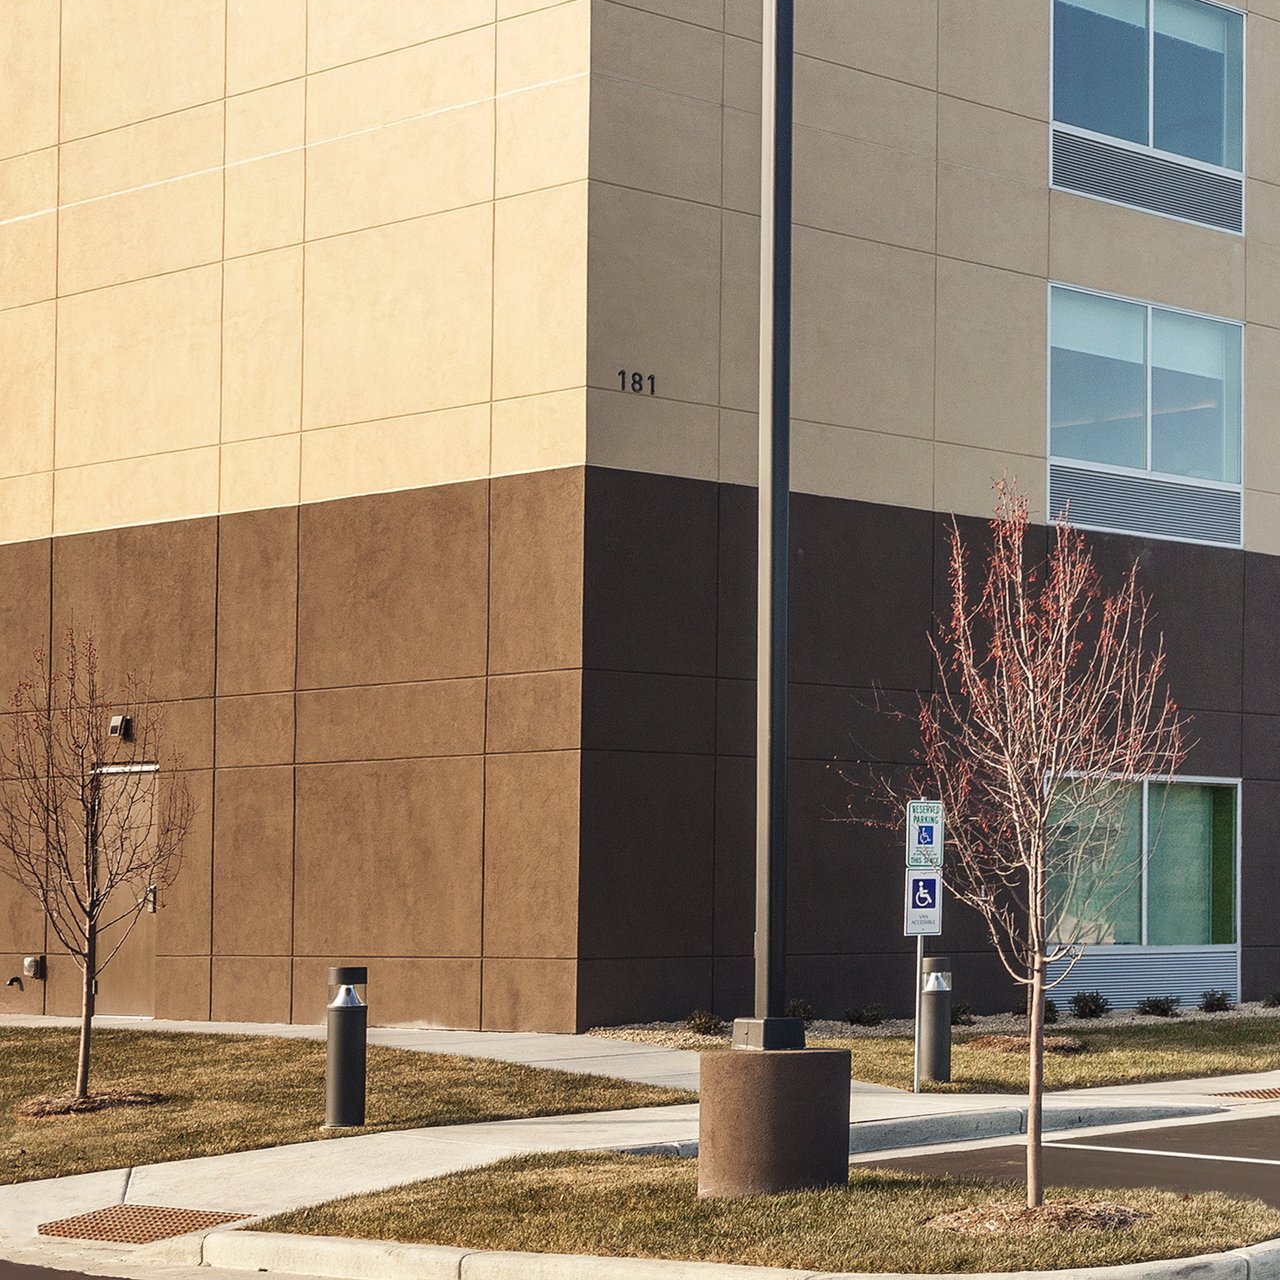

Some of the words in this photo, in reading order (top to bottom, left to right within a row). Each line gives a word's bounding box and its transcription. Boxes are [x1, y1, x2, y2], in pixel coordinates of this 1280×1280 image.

[618, 370, 655, 395] 181
[912, 805, 940, 814] RESERVED
[913, 816, 939, 824] PARKING
